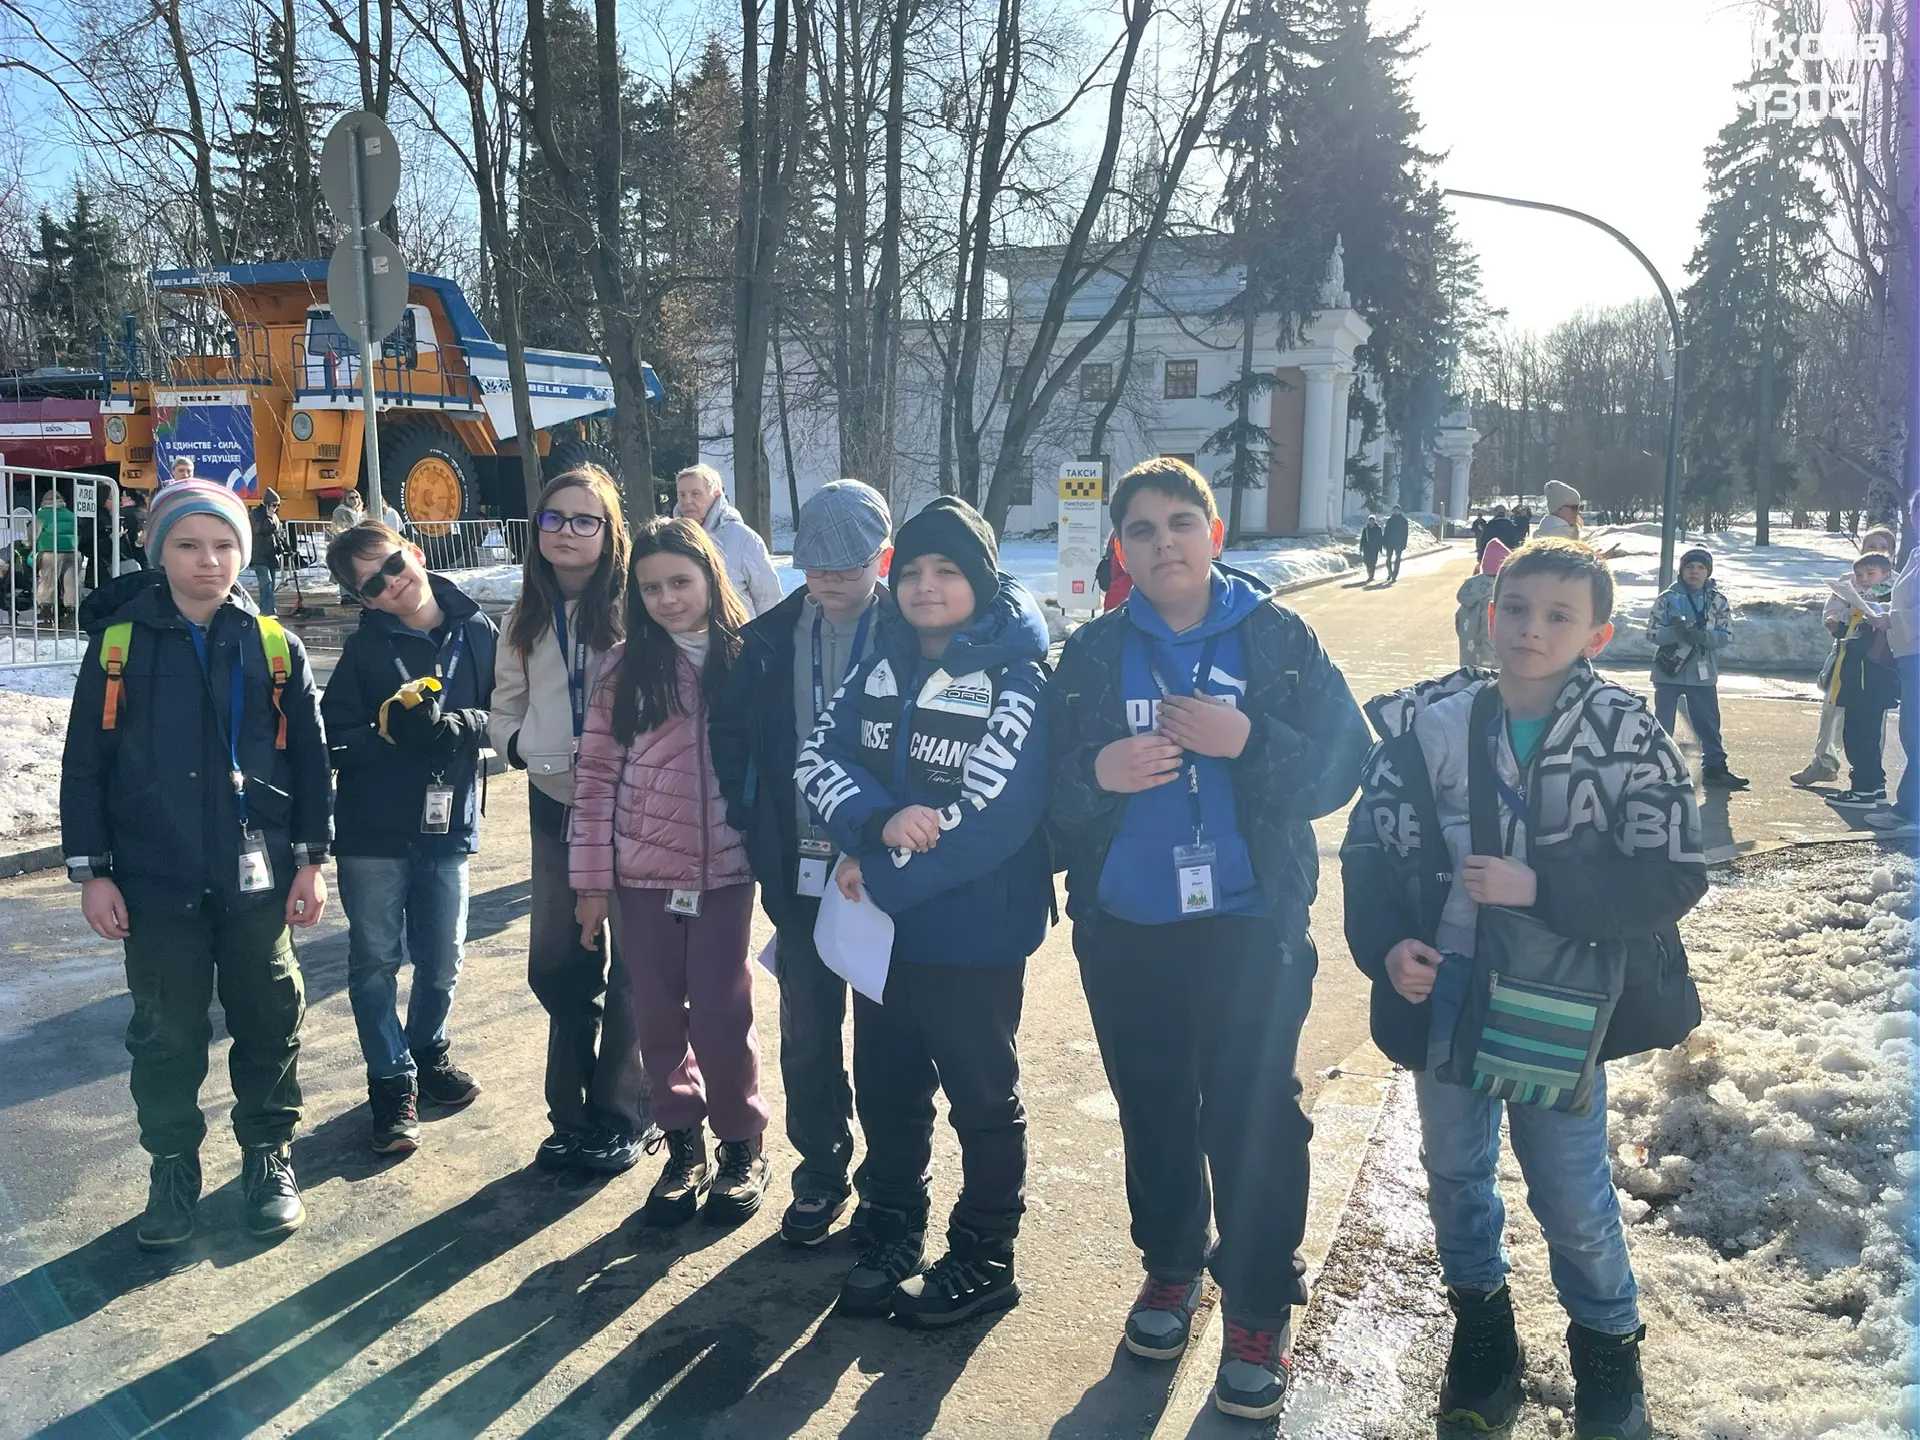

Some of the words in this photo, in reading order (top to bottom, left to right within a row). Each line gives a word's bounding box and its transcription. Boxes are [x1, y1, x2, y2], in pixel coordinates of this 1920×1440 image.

[529, 384, 569, 395] BELAZ
[172, 441, 212, 451] ЕДИНСТВЕ
[1066, 469, 1097, 478] ТАКСИ
